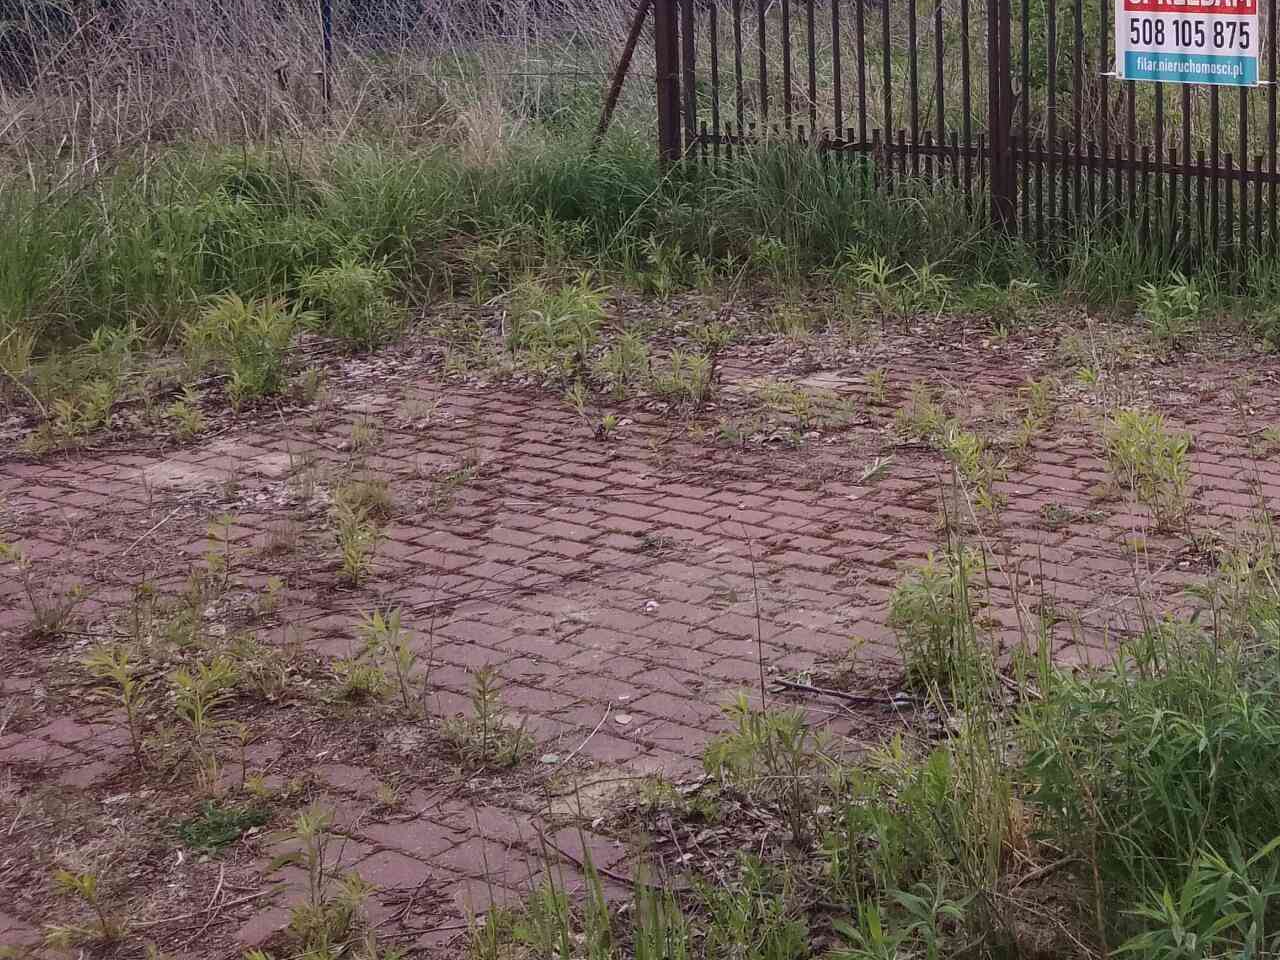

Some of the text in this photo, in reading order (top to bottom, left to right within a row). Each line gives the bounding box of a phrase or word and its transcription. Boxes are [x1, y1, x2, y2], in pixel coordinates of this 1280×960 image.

[1130, 18, 1250, 49] 508 105 875
[1137, 56, 1244, 79] filar.nieruchomosci.pl
